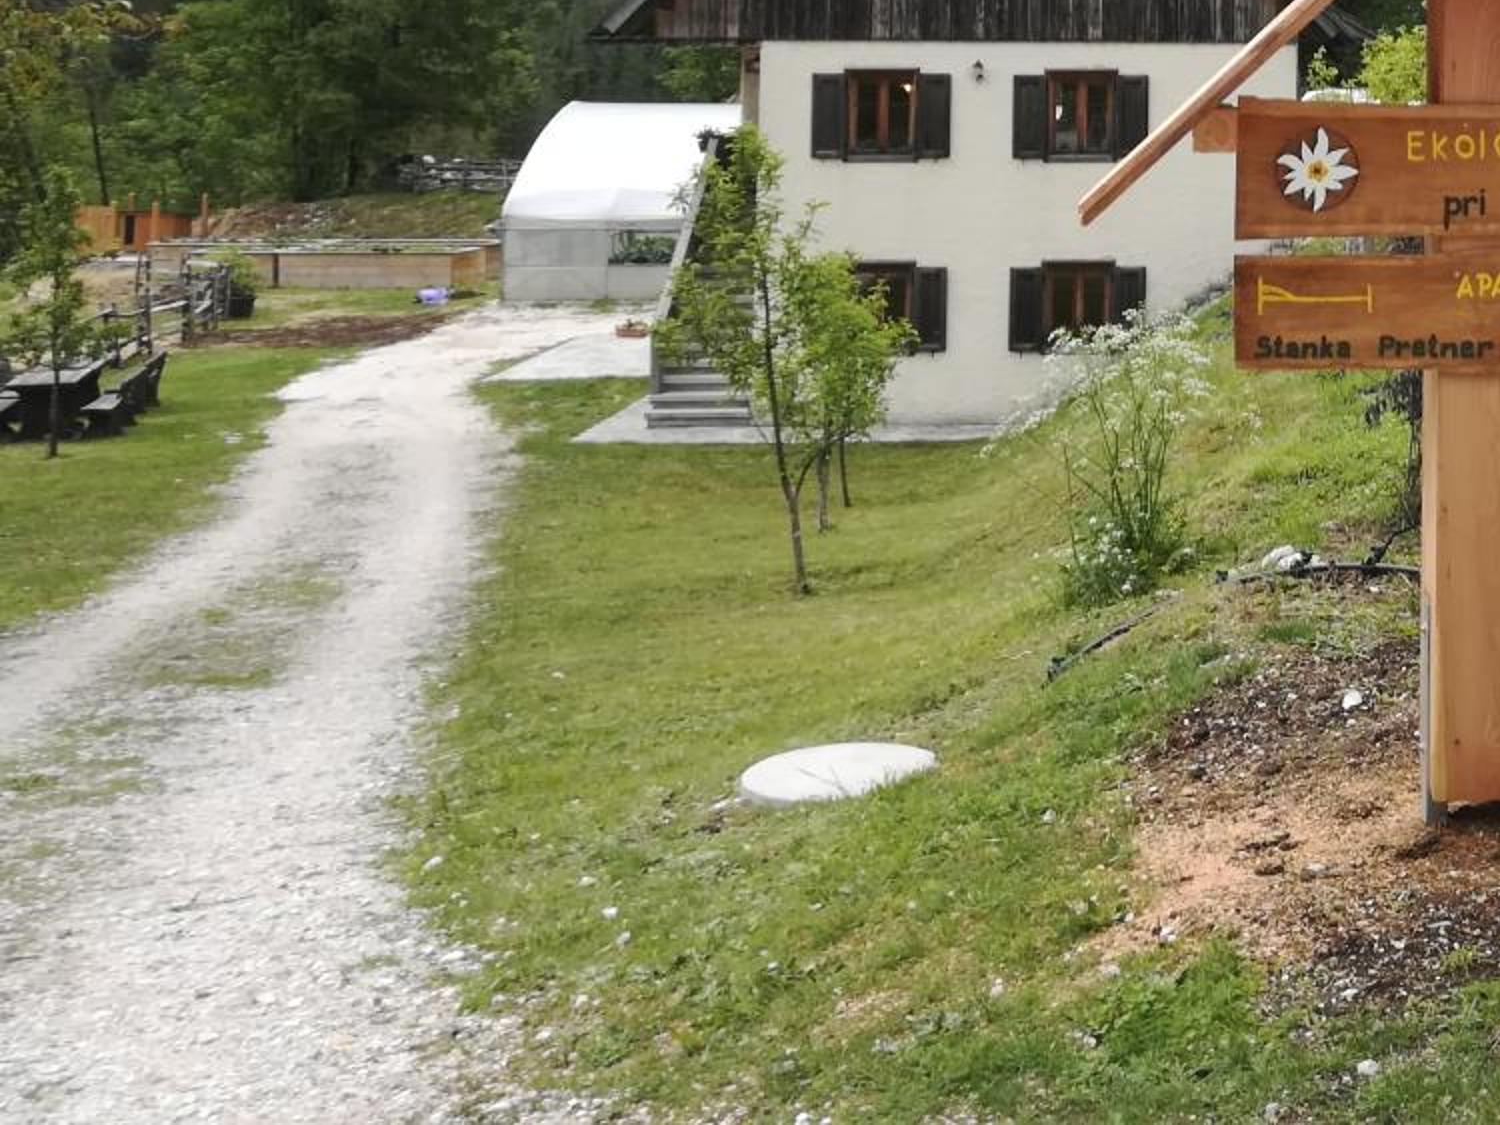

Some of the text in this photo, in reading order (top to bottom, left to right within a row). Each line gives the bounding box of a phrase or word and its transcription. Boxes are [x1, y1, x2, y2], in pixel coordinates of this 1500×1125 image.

[1443, 188, 1486, 231] pri
[1253, 334, 1351, 359] Stanka
[1377, 333, 1495, 359] Pretner
